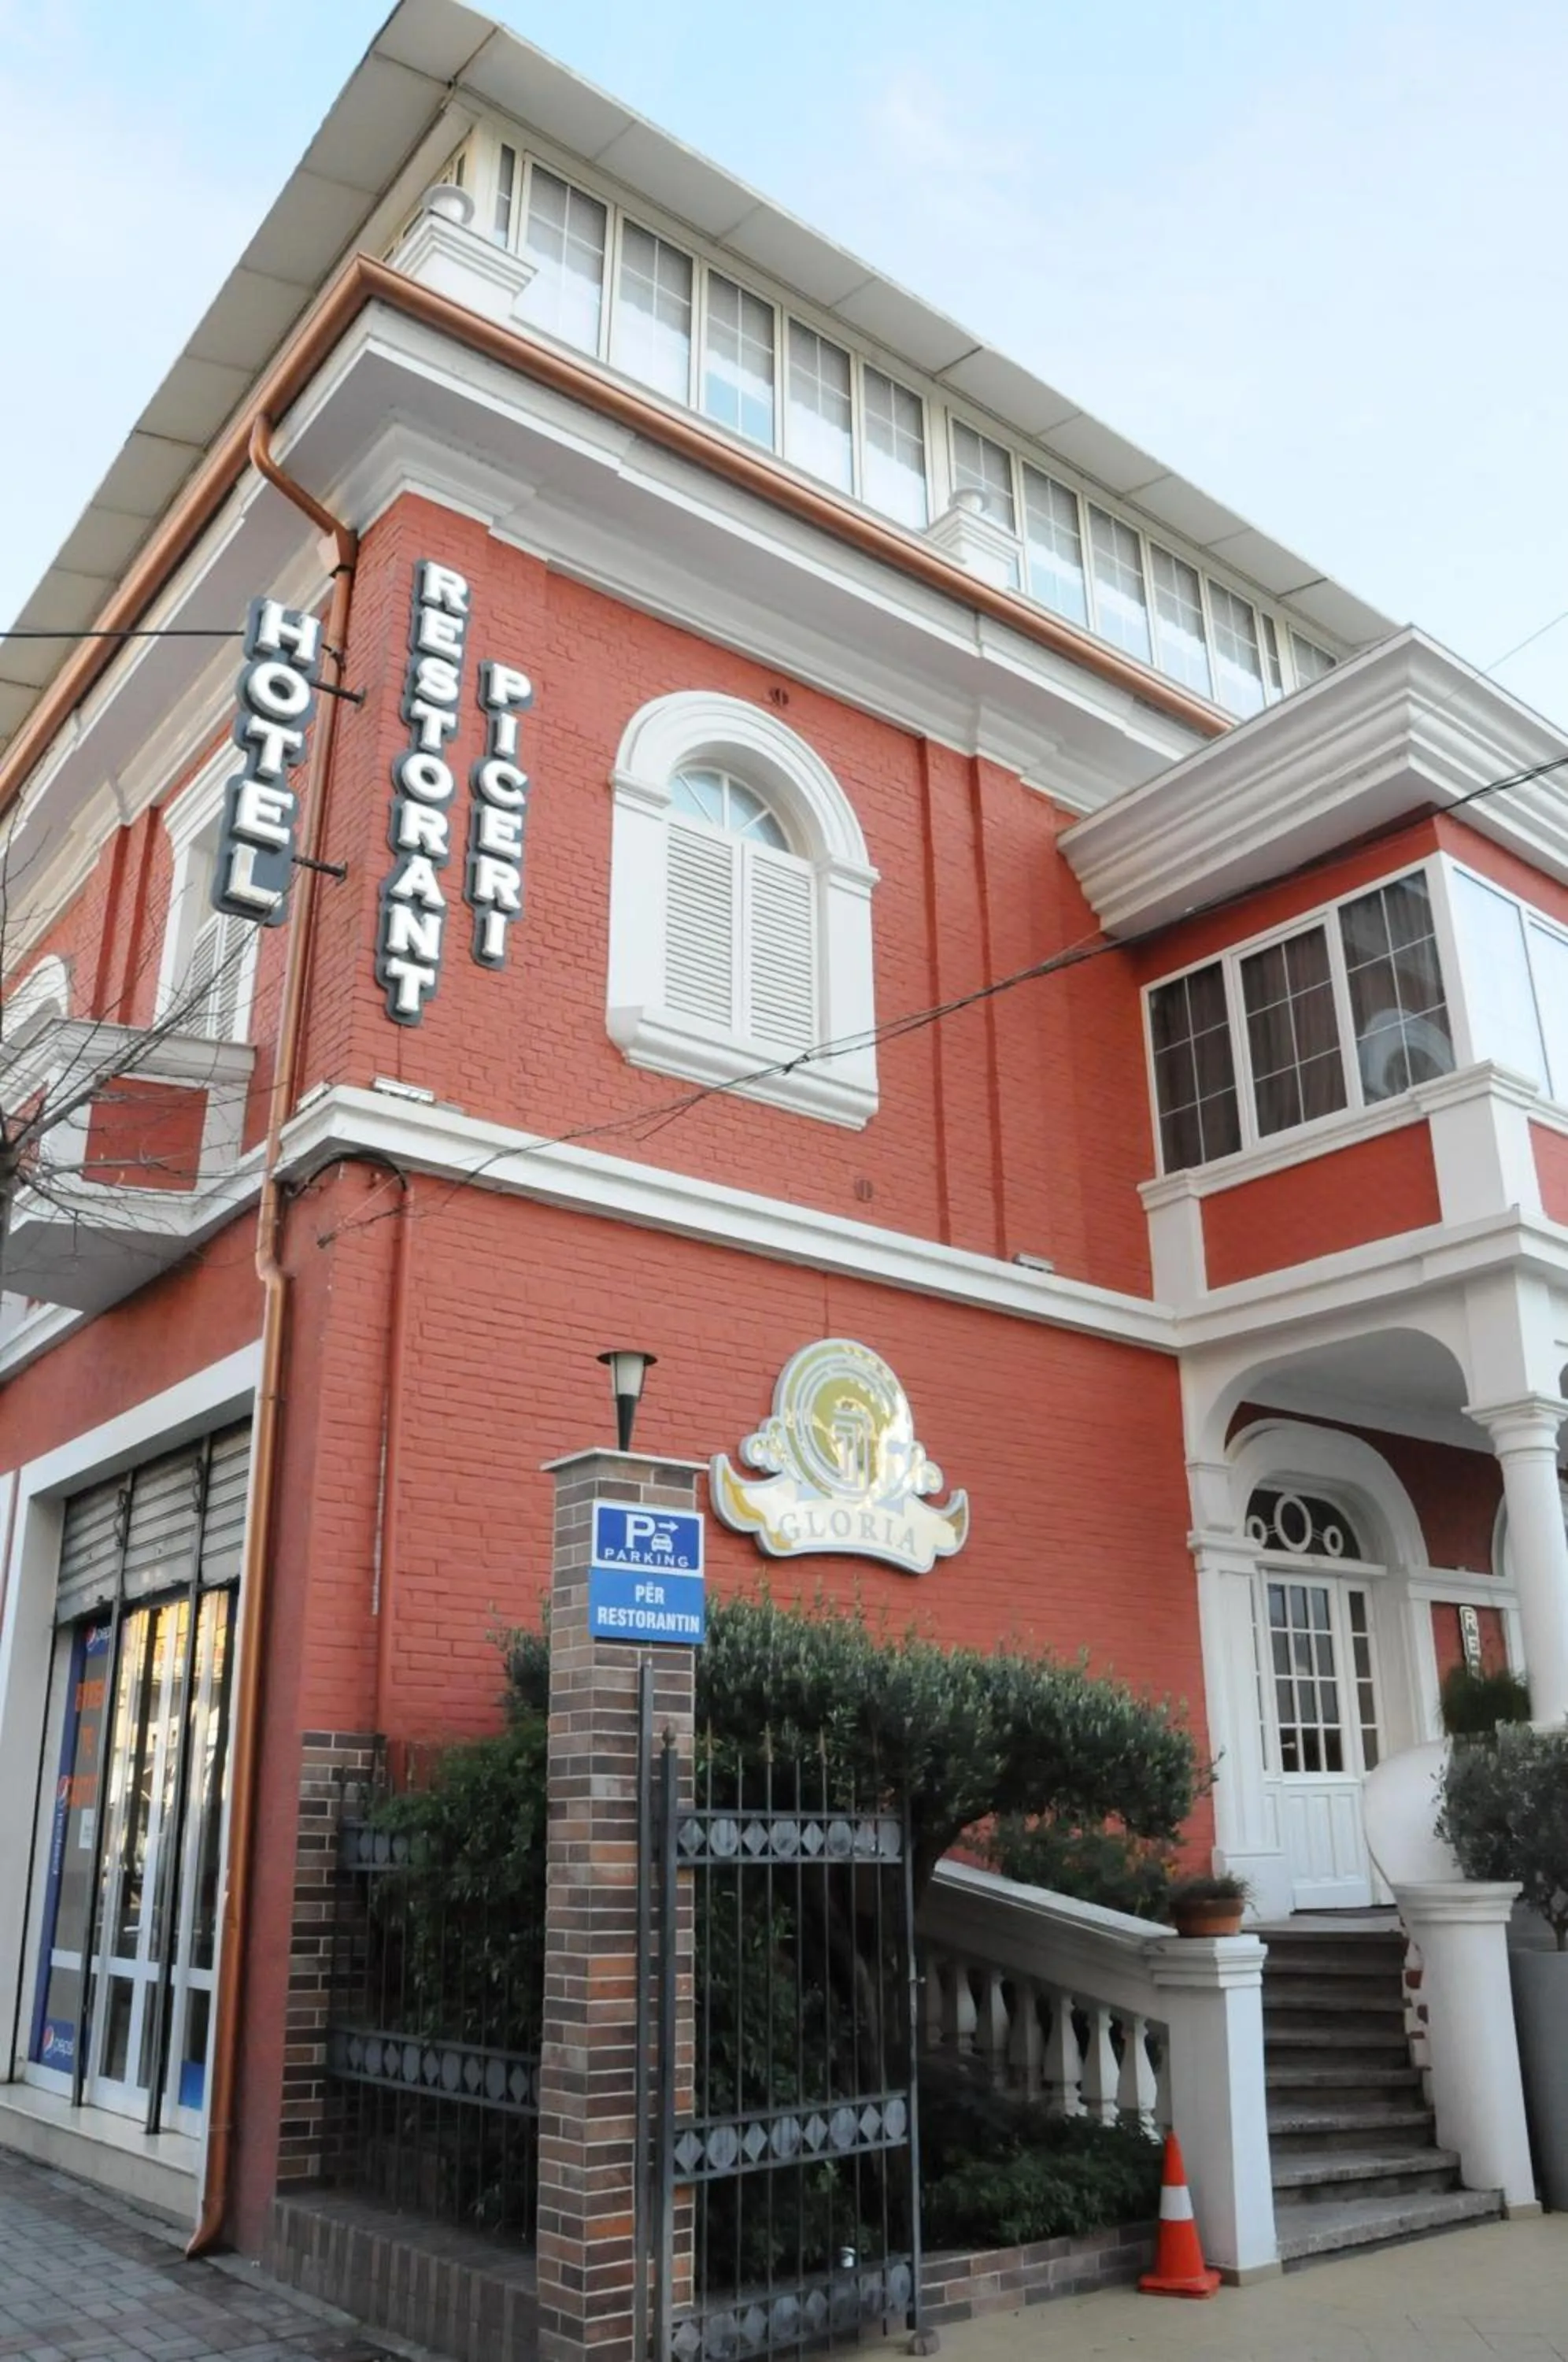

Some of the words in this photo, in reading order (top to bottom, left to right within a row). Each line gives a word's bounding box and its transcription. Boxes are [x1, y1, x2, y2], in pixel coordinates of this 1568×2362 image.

[225, 600, 321, 909] HOTEL
[387, 561, 468, 1013] RESTORANT
[475, 663, 532, 958] PICERI
[625, 1513, 656, 1549] P
[778, 1509, 917, 1557] GLORIA
[604, 1547, 690, 1568] PARKING
[634, 1581, 665, 1605] PËR
[597, 1605, 700, 1634] RESTORANTIN
